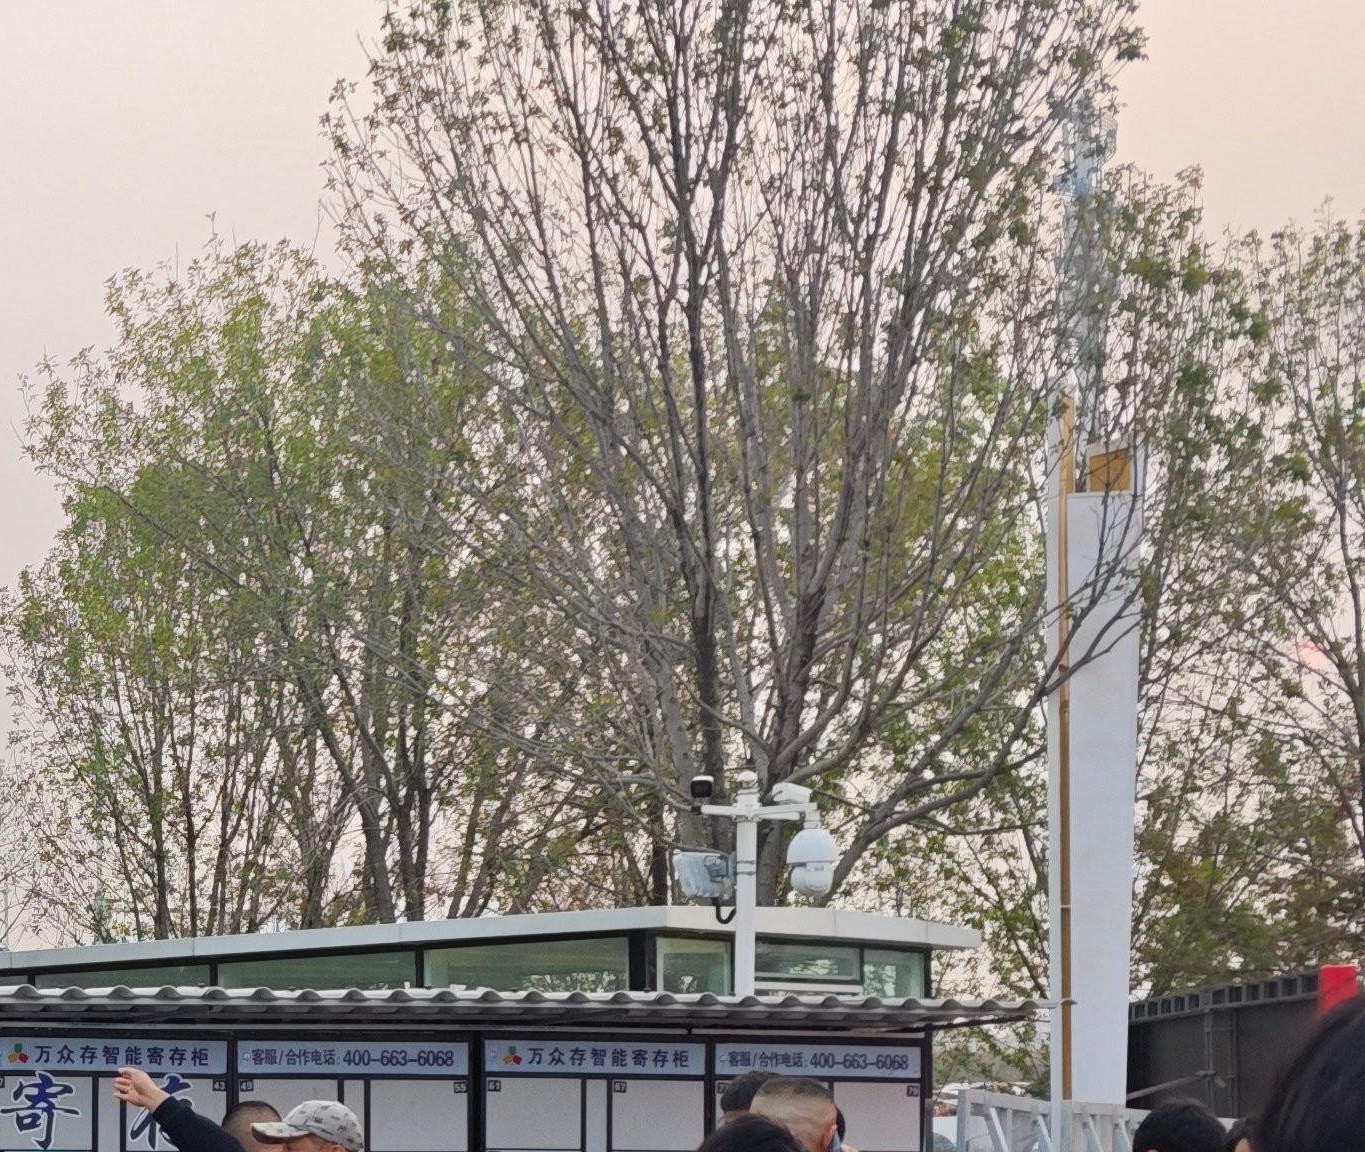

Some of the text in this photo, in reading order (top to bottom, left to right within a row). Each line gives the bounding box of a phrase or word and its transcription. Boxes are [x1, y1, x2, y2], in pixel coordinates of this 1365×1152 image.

[34, 1044, 209, 1067] 万众存智能寄存柜
[342, 1049, 455, 1068] 400-663-6068
[527, 1046, 689, 1069] 万众存智能寄存柜
[809, 1052, 909, 1070] 400-663-6068
